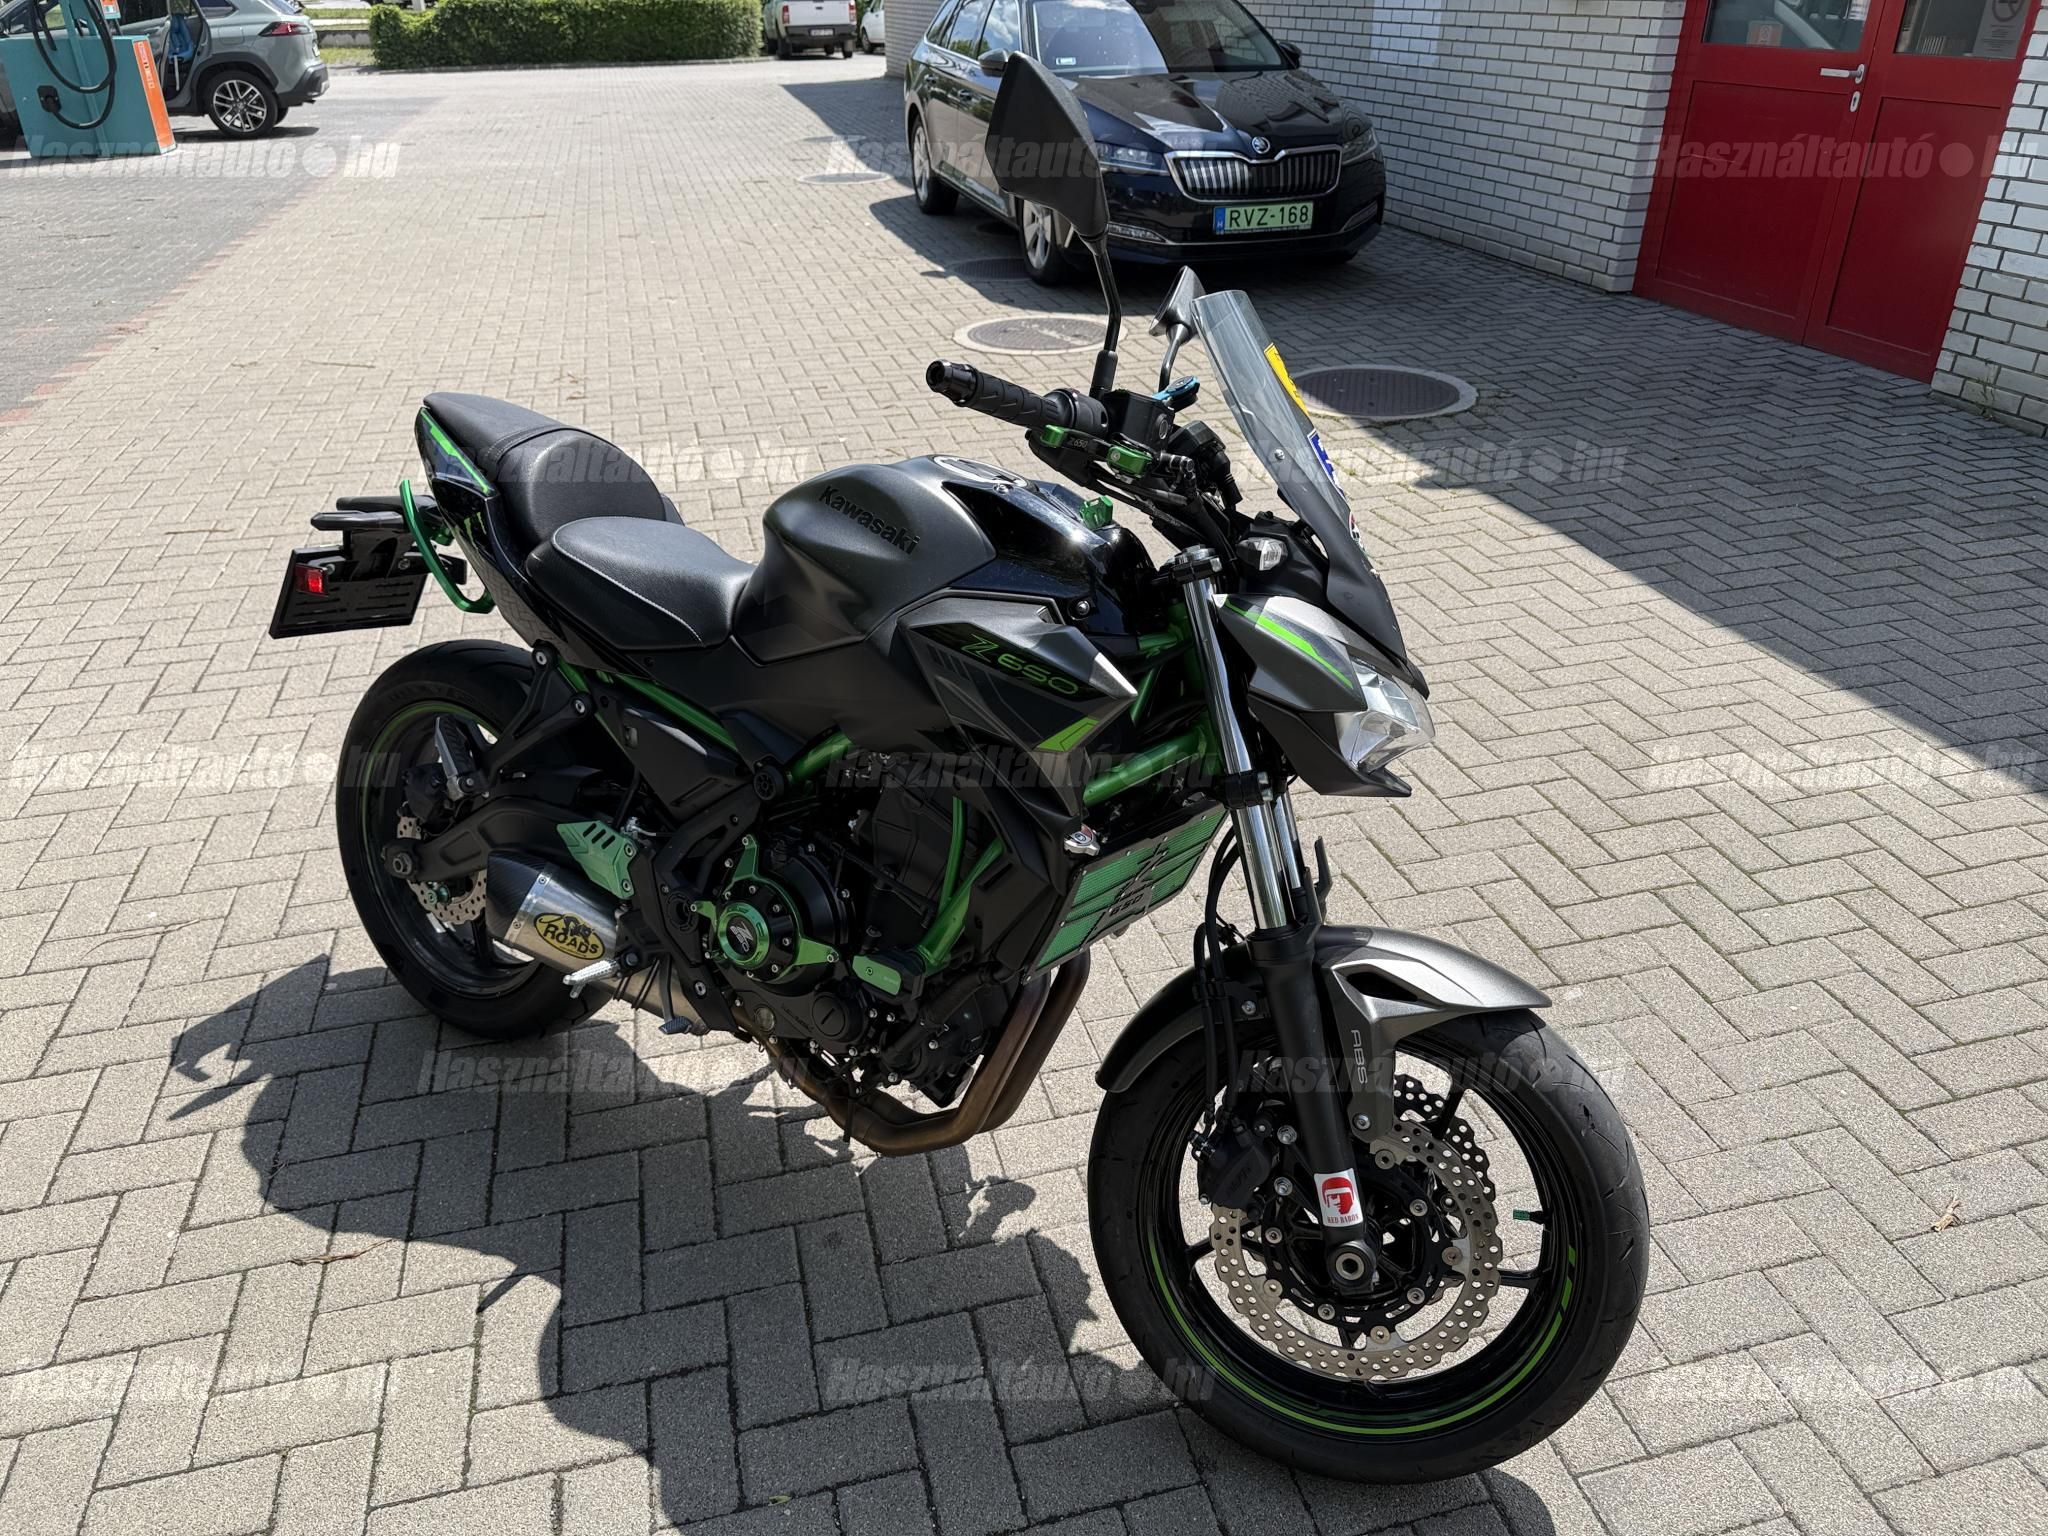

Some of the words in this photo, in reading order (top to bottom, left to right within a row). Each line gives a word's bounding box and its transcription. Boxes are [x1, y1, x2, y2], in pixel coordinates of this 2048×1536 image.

[1229, 205, 1309, 228] RVZ-168
[819, 486, 920, 555] Kawasaki
[543, 923, 599, 954] ROADS
[1351, 1029, 1368, 1084] ABS
